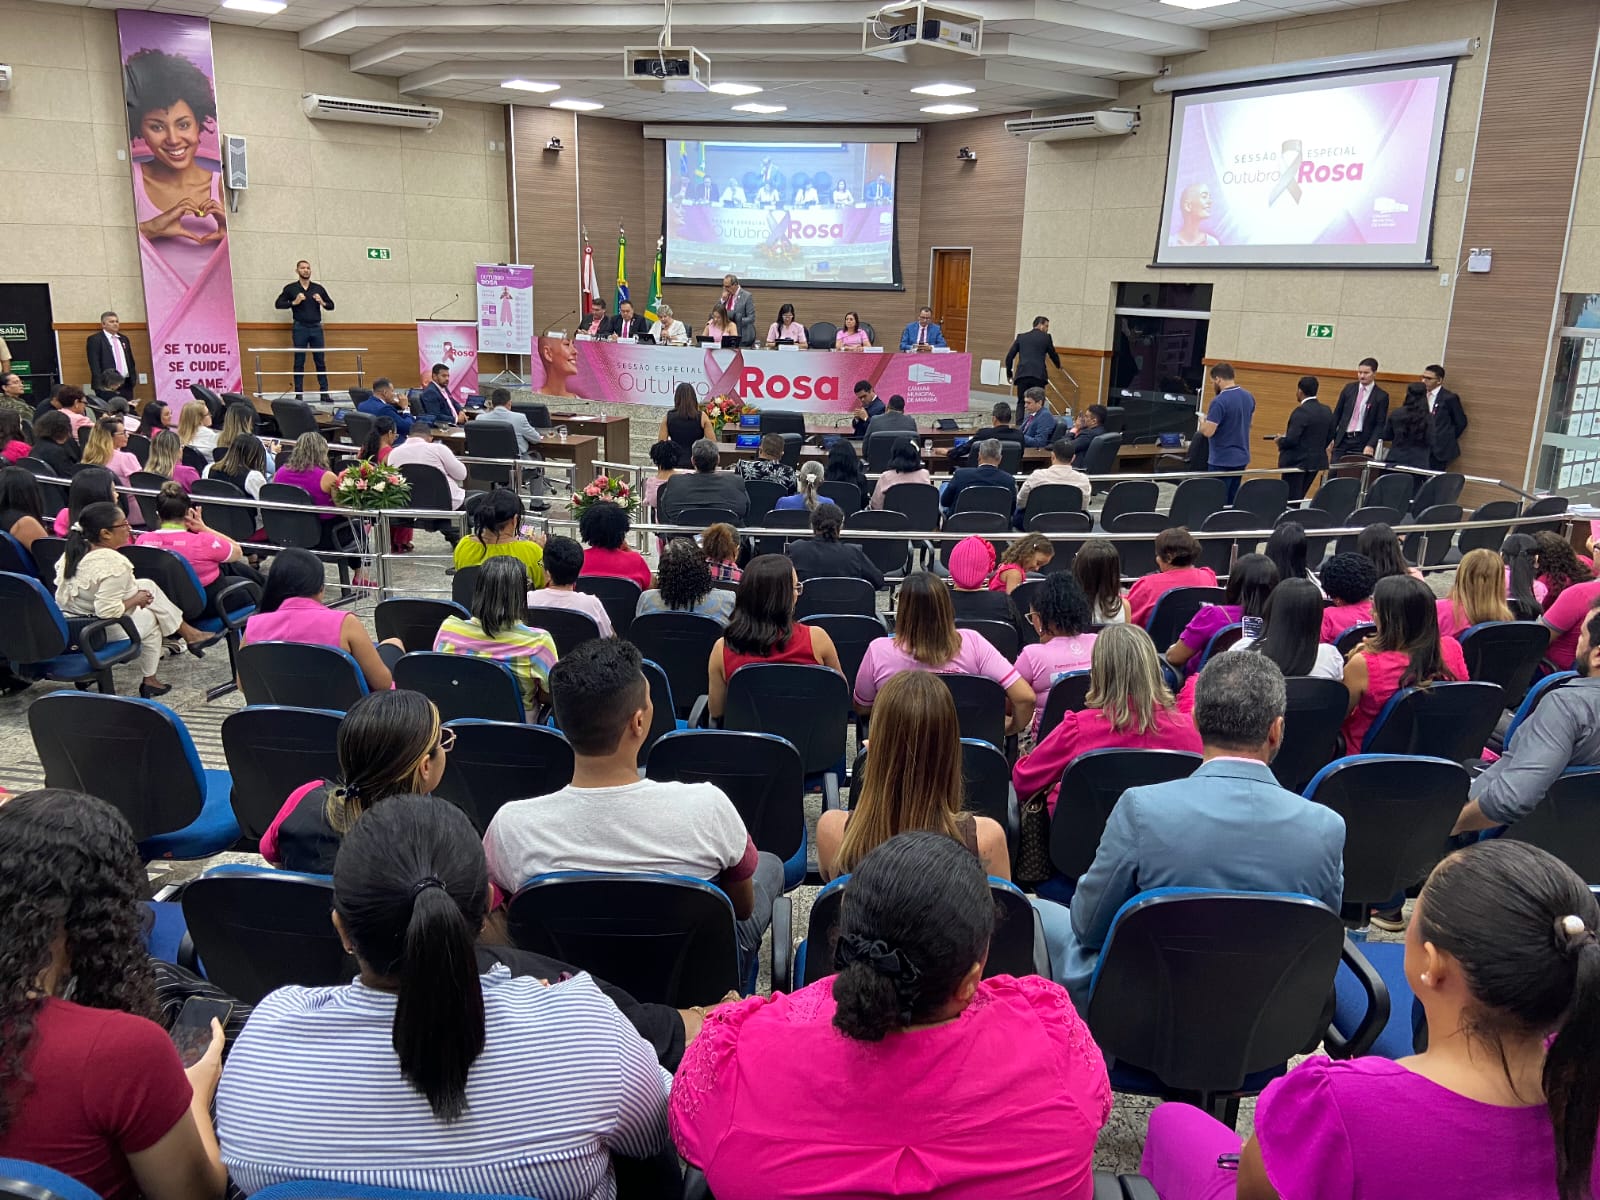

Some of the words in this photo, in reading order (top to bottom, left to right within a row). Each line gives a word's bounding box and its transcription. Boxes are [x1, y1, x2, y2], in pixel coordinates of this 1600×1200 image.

[1307, 146, 1357, 158] ESPECIAL
[1222, 169, 1281, 185] Outubro
[1297, 160, 1364, 184] Rosa
[712, 224, 771, 240] Outubro
[787, 220, 844, 239] Rosa
[164, 343, 180, 355] SE
[185, 343, 231, 355] TOQUE,
[168, 361, 185, 372] SE
[655, 364, 702, 374] ESPECIAL
[175, 379, 190, 390] SE
[739, 366, 839, 401] Rosa
